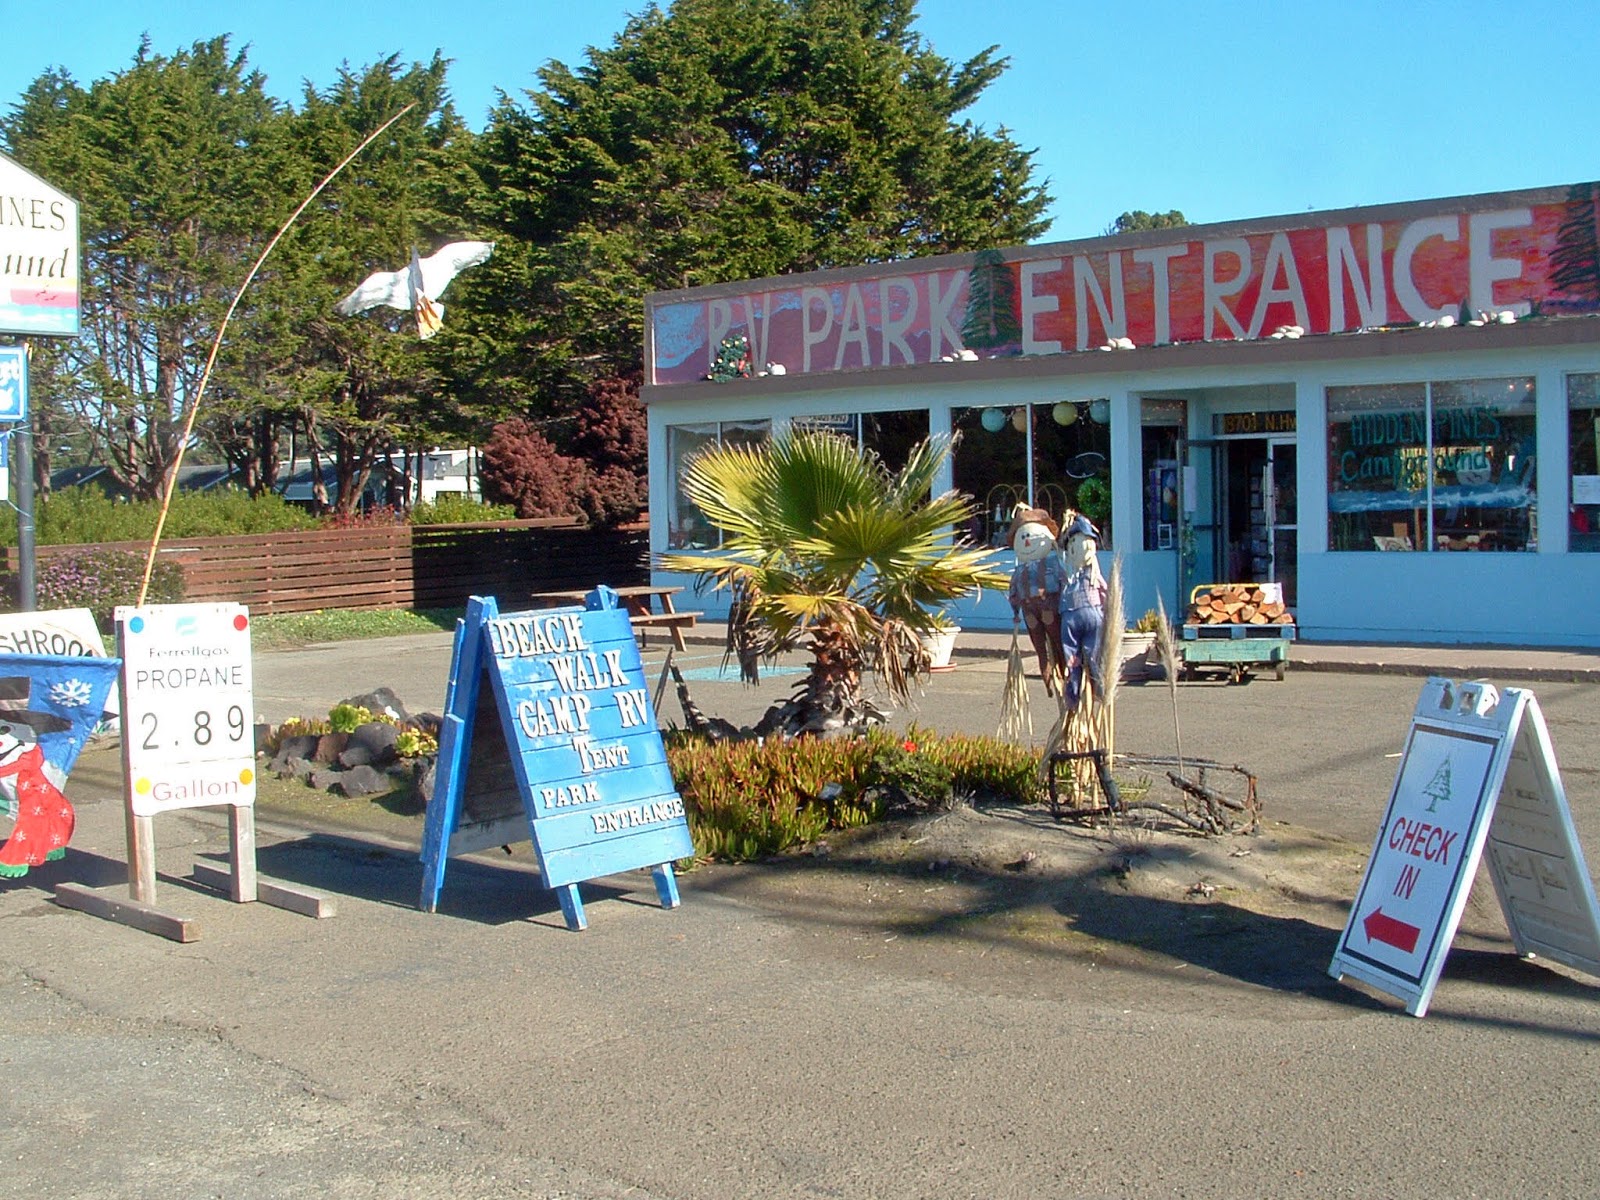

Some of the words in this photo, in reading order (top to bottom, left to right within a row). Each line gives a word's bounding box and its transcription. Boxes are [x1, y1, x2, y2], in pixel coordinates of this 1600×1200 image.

[707, 292, 772, 373] RV
[802, 269, 968, 373] PARK
[1019, 208, 1534, 356] ENTRANCE
[1350, 409, 1427, 447] HIDDEN
[1433, 404, 1502, 441] PINES
[0, 629, 94, 656] SHROO
[148, 645, 230, 659] Ferrellgas
[494, 613, 589, 659] BEACH
[135, 665, 244, 691] PROPANE
[550, 649, 630, 693] WALK
[141, 705, 245, 751] 2.89
[516, 693, 592, 739] CAMP
[613, 688, 648, 728] RV
[571, 734, 631, 774] TENT
[152, 779, 238, 802] Gallon
[541, 781, 600, 809] PARK
[590, 798, 685, 834] ENTRANCE
[1388, 817, 1458, 866] CHECK
[1393, 864, 1421, 901] IN
